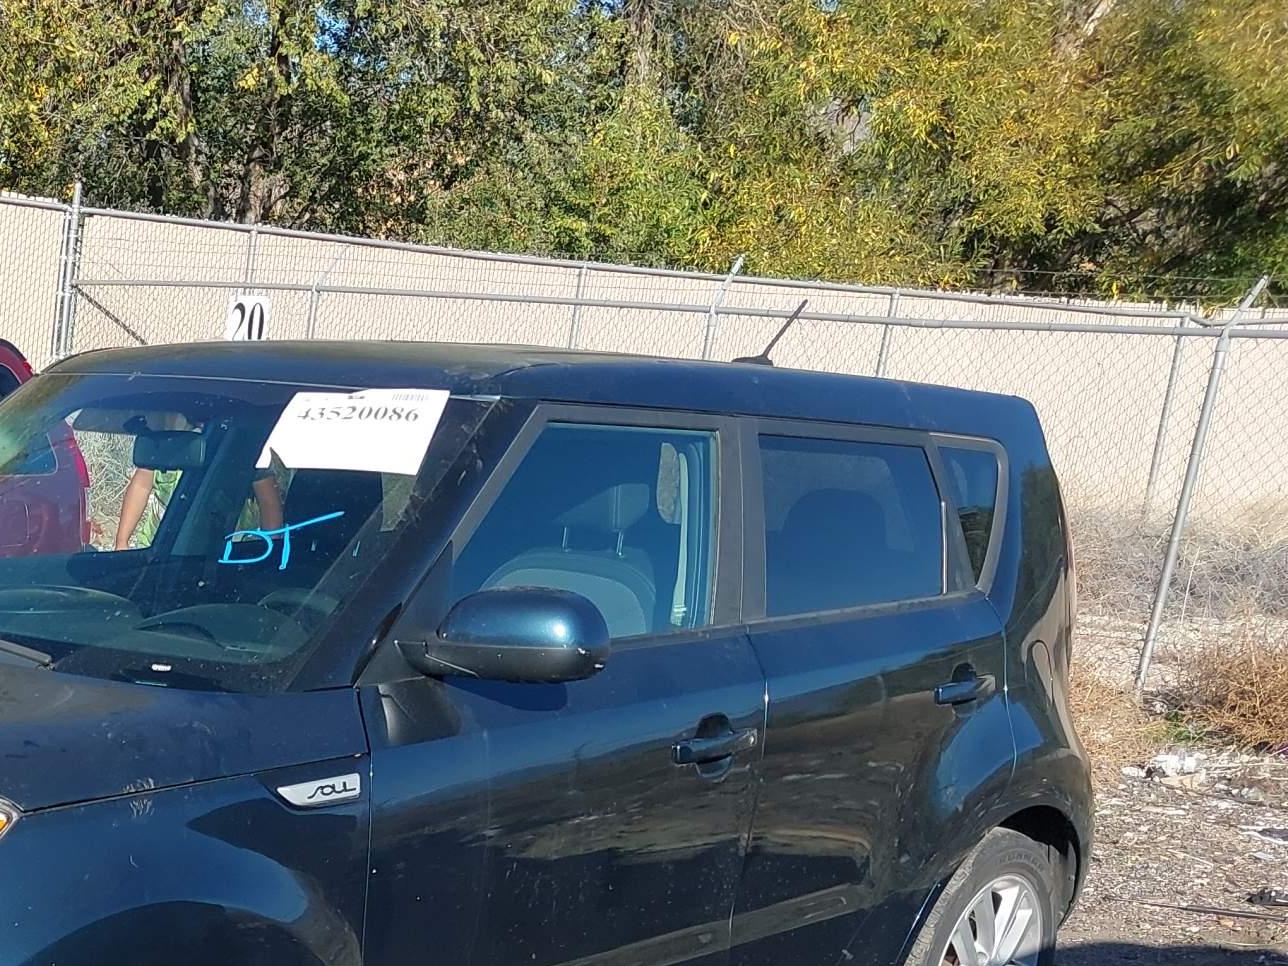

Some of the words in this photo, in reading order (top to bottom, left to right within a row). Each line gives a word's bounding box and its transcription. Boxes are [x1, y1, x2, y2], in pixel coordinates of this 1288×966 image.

[231, 302, 265, 341] 20
[297, 405, 420, 423] 43520086
[217, 510, 345, 570] DT
[307, 781, 357, 799] SOUL
